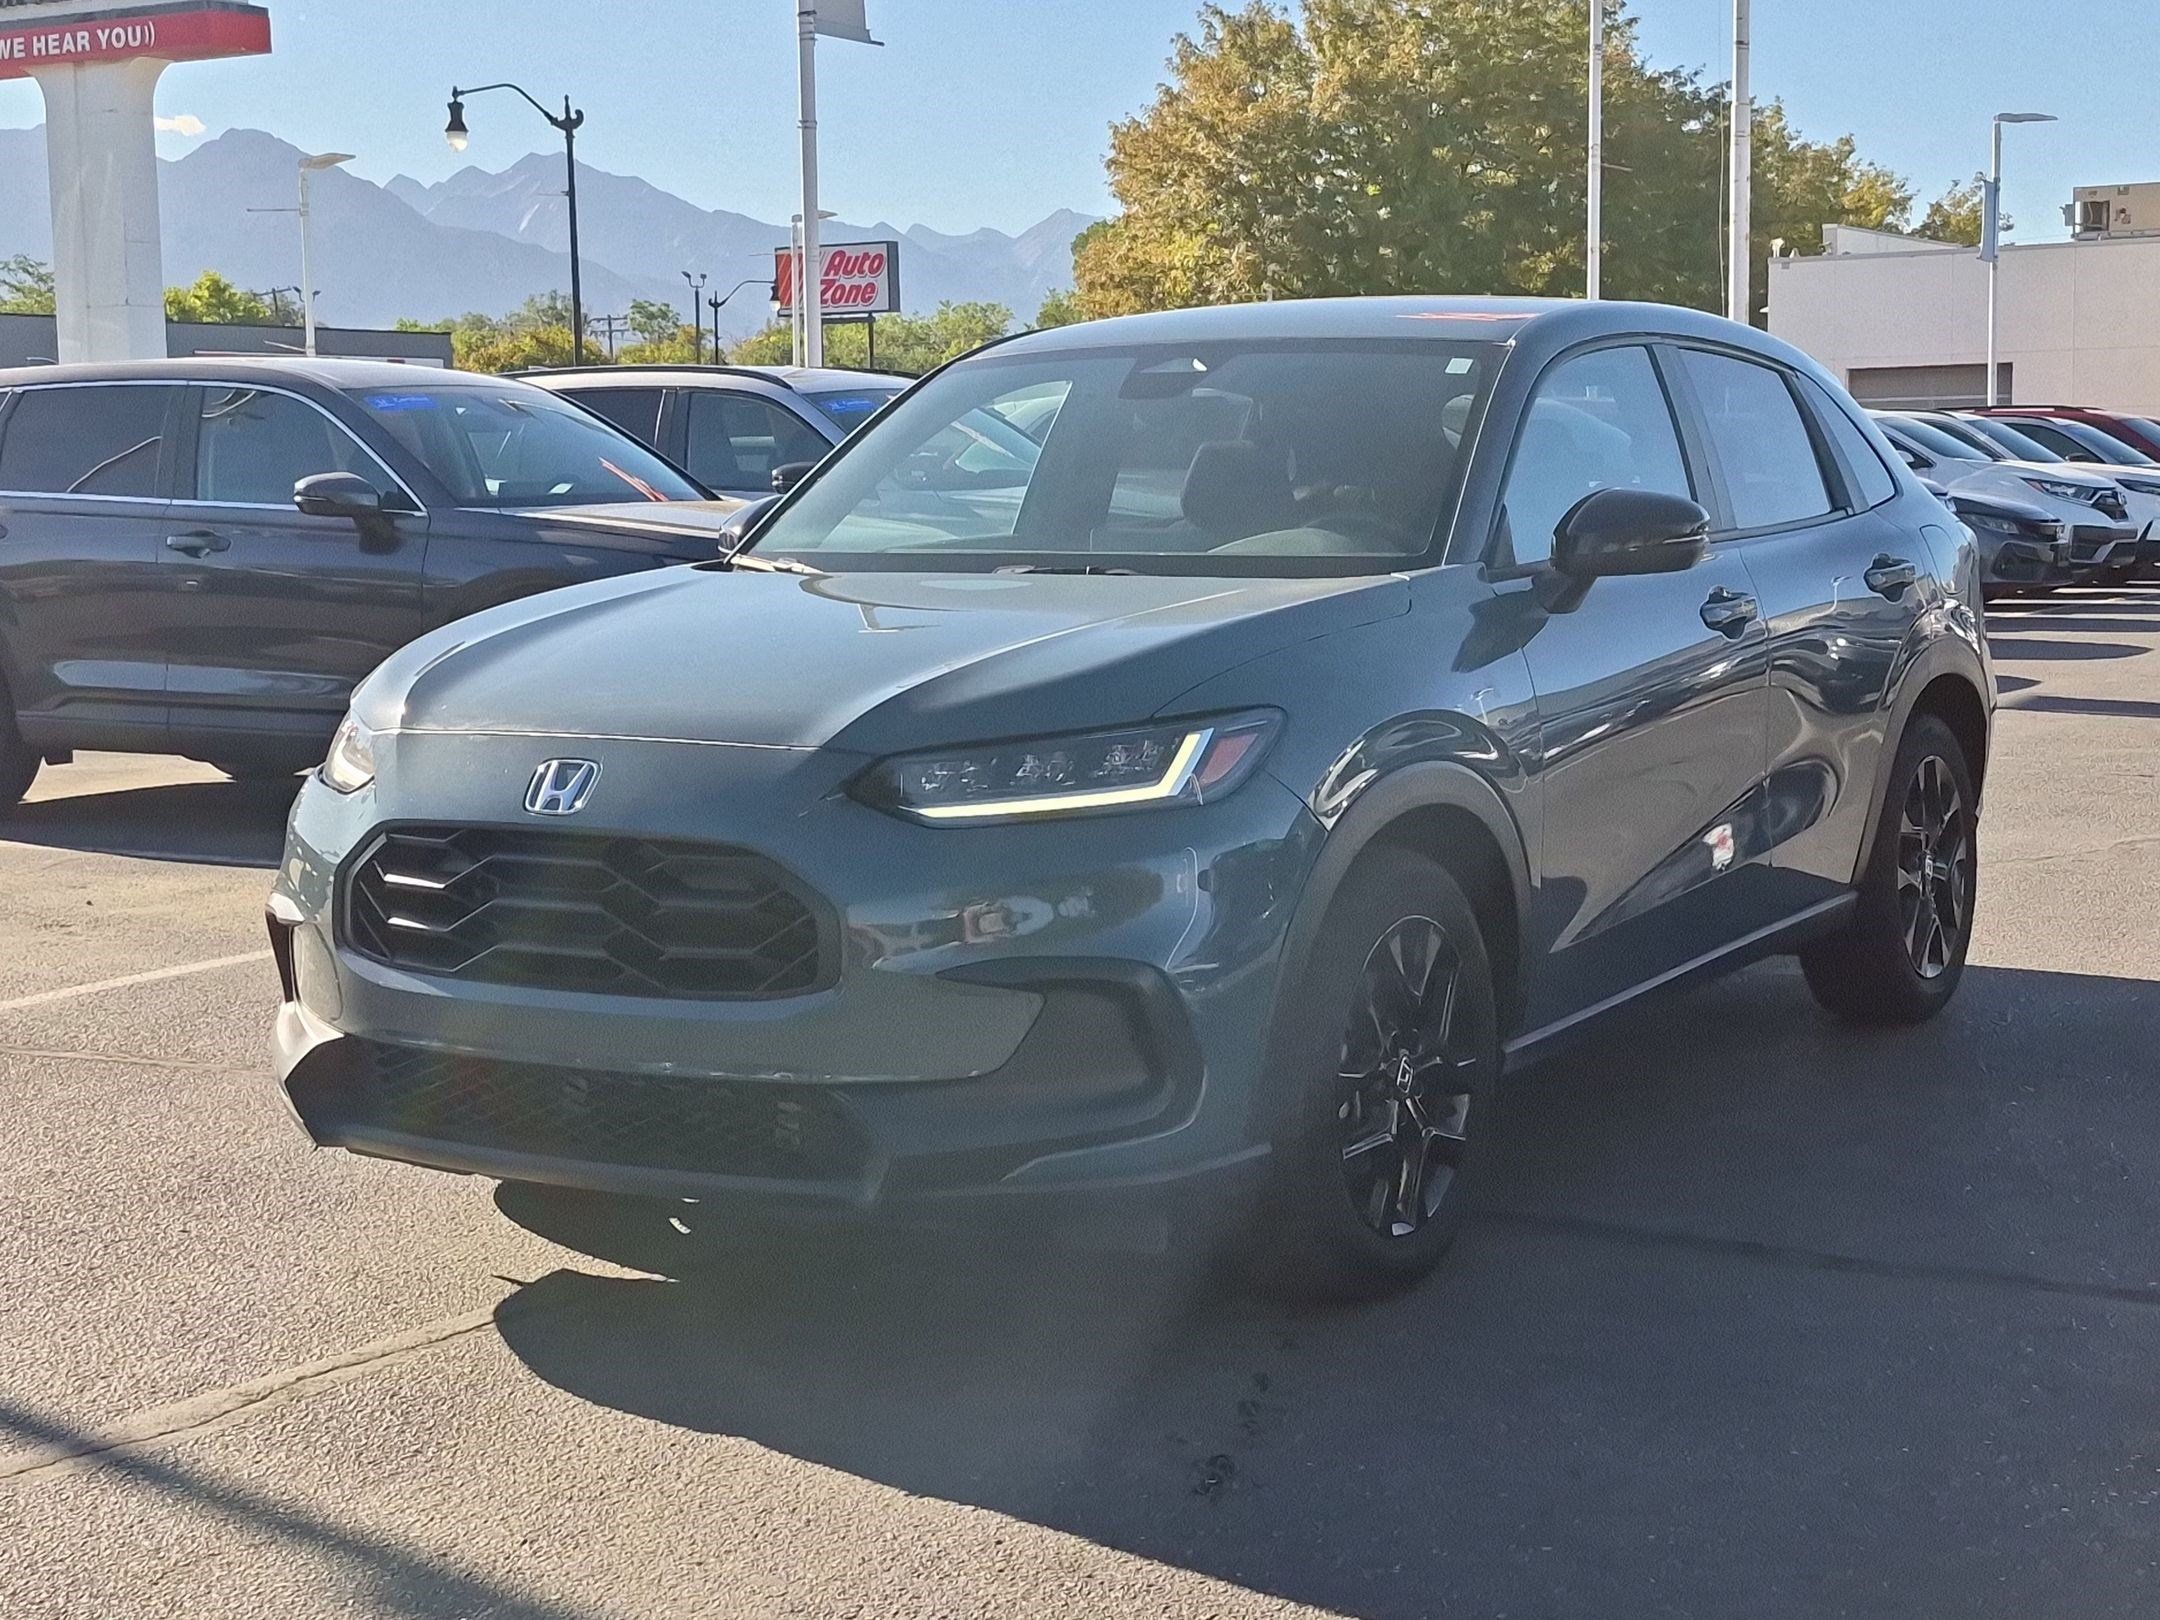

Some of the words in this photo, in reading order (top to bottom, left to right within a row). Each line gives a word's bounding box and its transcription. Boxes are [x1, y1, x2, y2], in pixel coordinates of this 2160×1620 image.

[32, 30, 91, 57] HEAR
[823, 249, 885, 279] Auto
[820, 279, 877, 306] Zone
